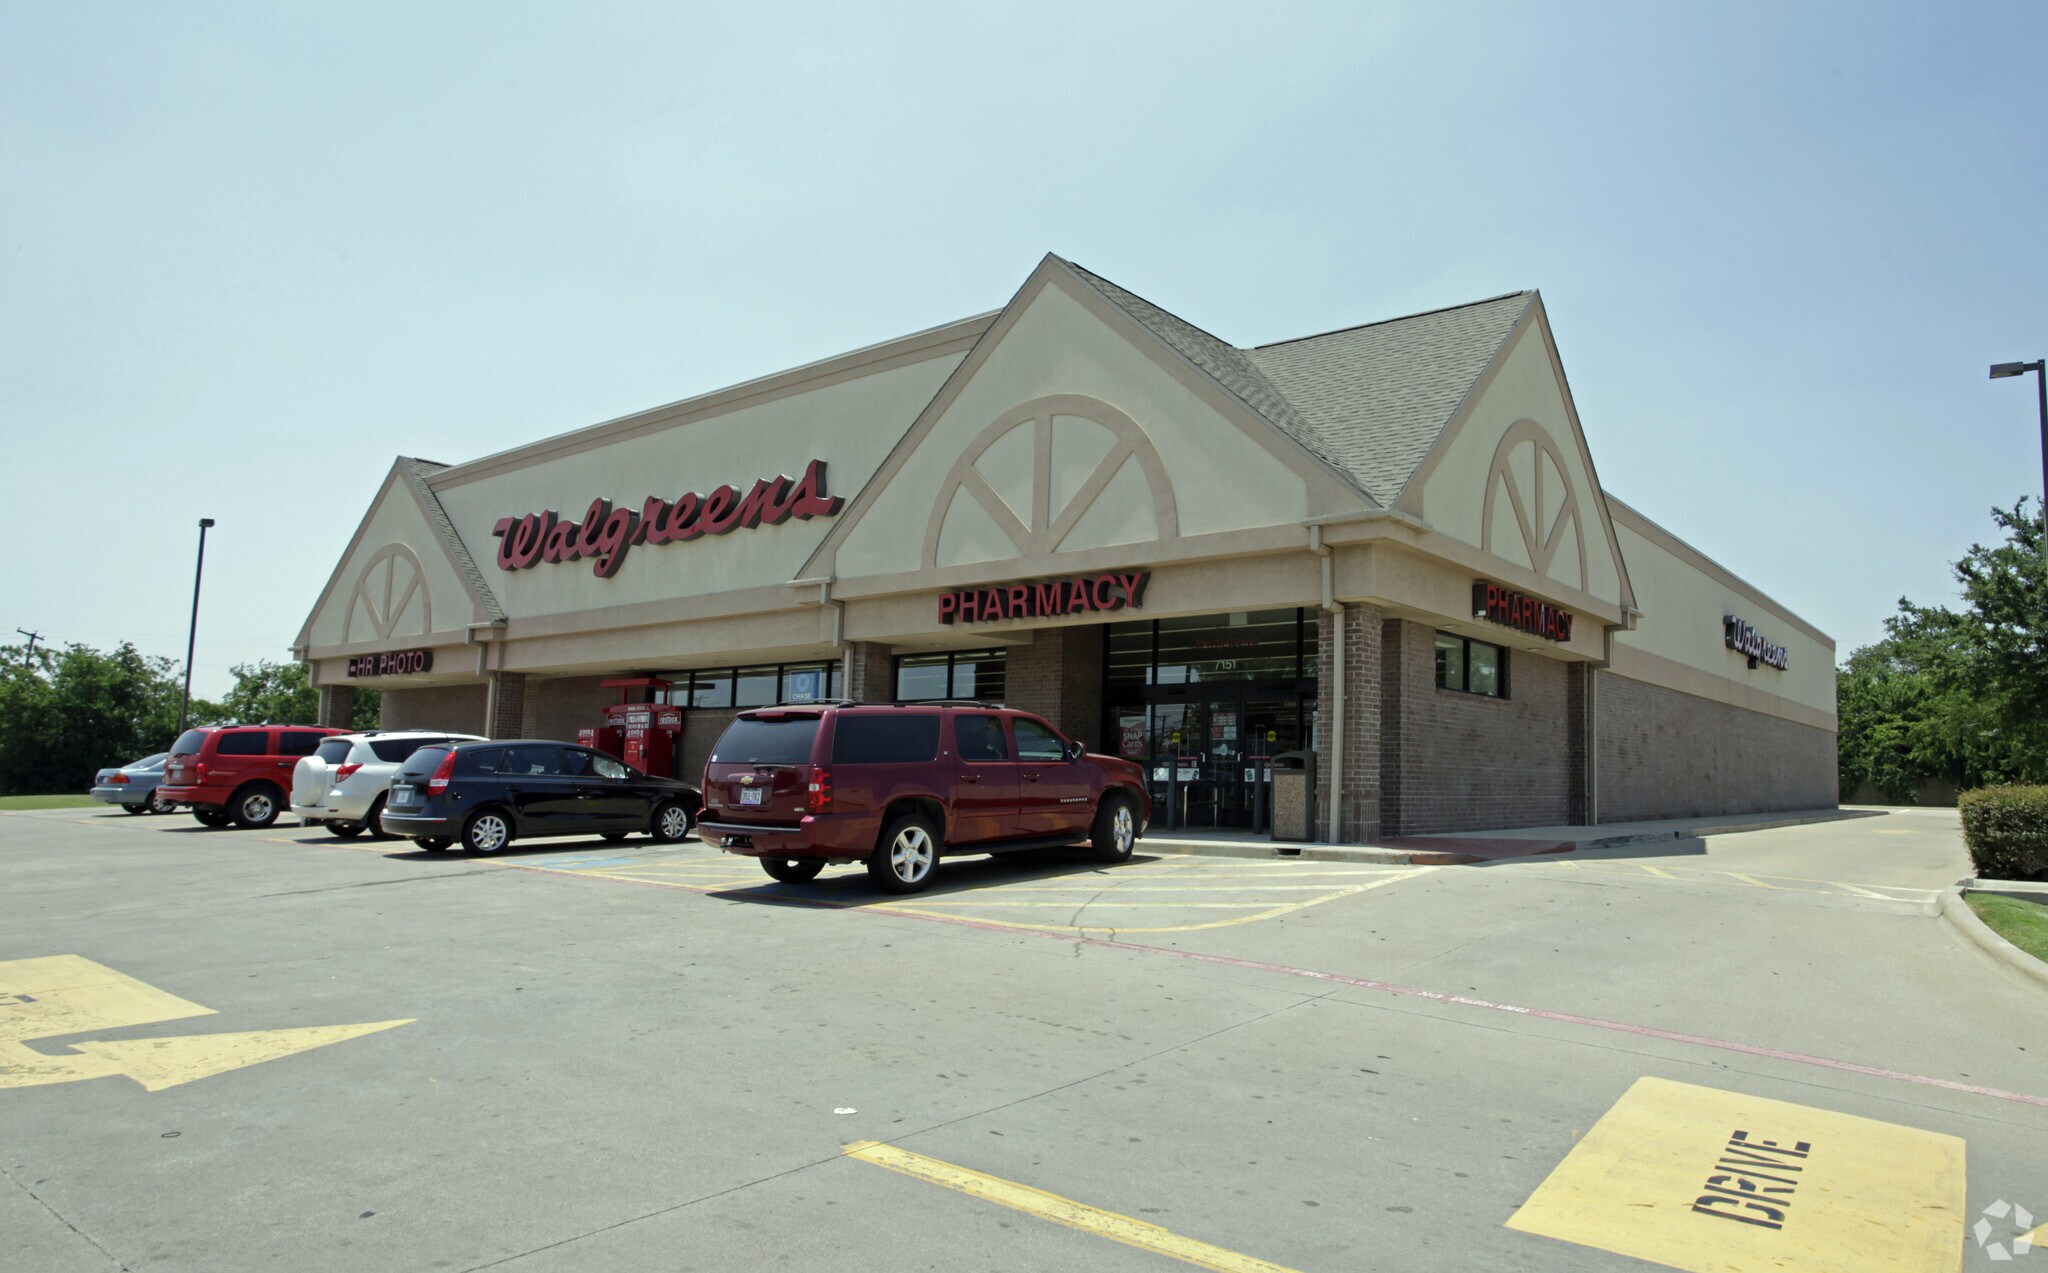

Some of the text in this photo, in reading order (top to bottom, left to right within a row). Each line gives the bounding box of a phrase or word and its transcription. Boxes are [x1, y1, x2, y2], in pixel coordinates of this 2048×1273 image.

[492, 458, 845, 578] Walgreens
[938, 571, 1148, 625] PHARMACY
[1485, 583, 1574, 641] PHARMACY
[379, 650, 425, 675] PHOTO
[1215, 659, 1237, 670] 7151
[792, 692, 812, 700] CHASE
[1122, 731, 1143, 740] SNAP
[1122, 740, 1143, 748] Cards
[1692, 1129, 1812, 1231] DRIVE
